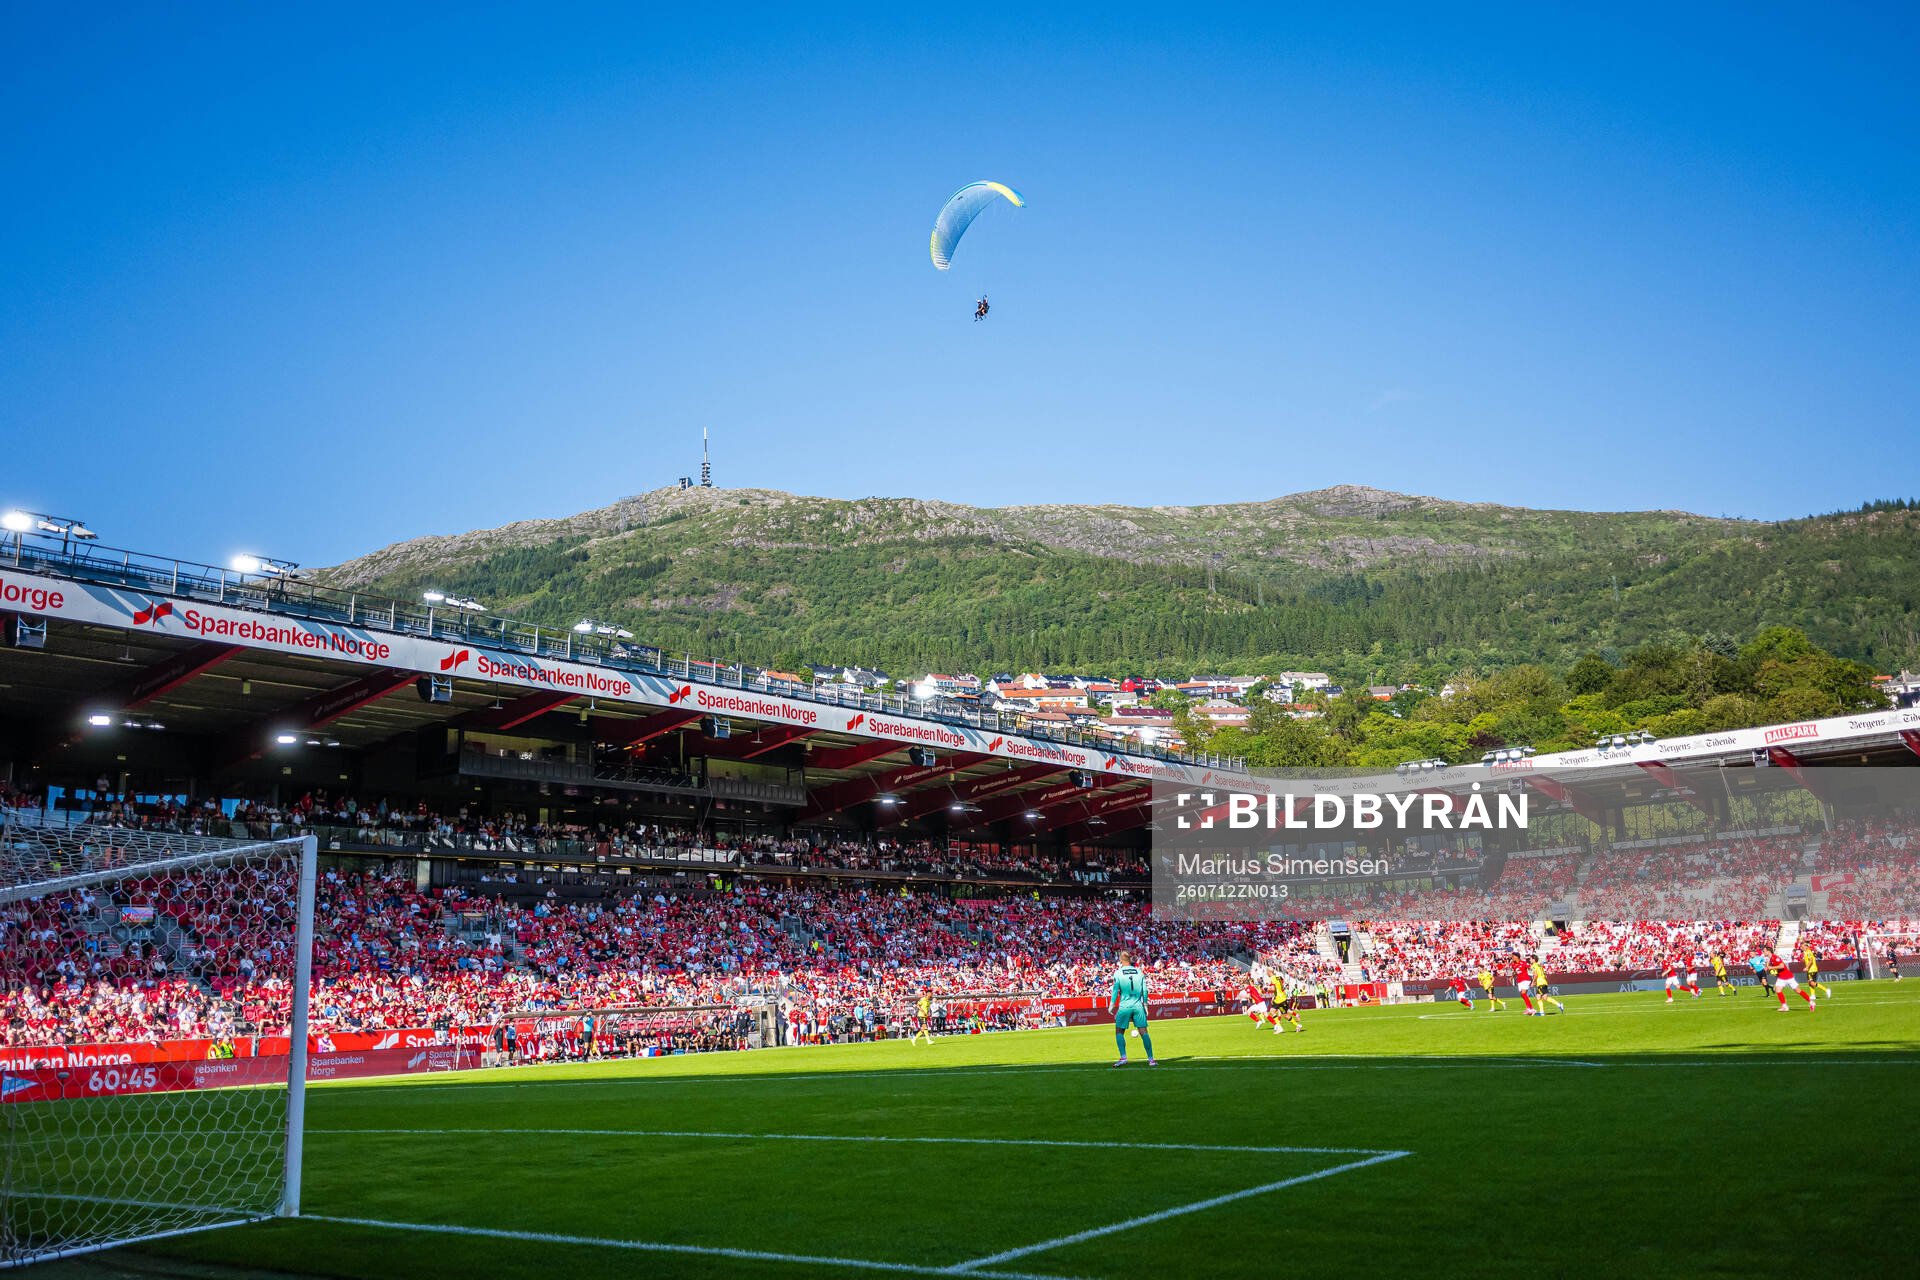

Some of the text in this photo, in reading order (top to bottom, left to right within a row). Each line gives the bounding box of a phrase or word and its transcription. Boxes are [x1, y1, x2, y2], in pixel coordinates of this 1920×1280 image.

[184, 609, 390, 660] Sparebanken Norge
[477, 655, 631, 696] Sparebanken Norge
[697, 690, 817, 725] Sparebanken Norge
[869, 718, 965, 747] Sparebanken Norge
[1766, 725, 1817, 743] BALLSPARK
[1849, 719, 1886, 730] Bergens
[1007, 740, 1086, 766] Sparebanken Norge
[1658, 736, 1737, 753] Bergens Tidende
[1559, 750, 1632, 766] Bergens Tidende
[1120, 759, 1186, 780] Sparebanken Norge
[1214, 774, 1271, 793] Sparebanken Norge
[311, 1056, 365, 1067] Sparebanken
[311, 1066, 336, 1076] Norge
[88, 1067, 157, 1092] 60:45
